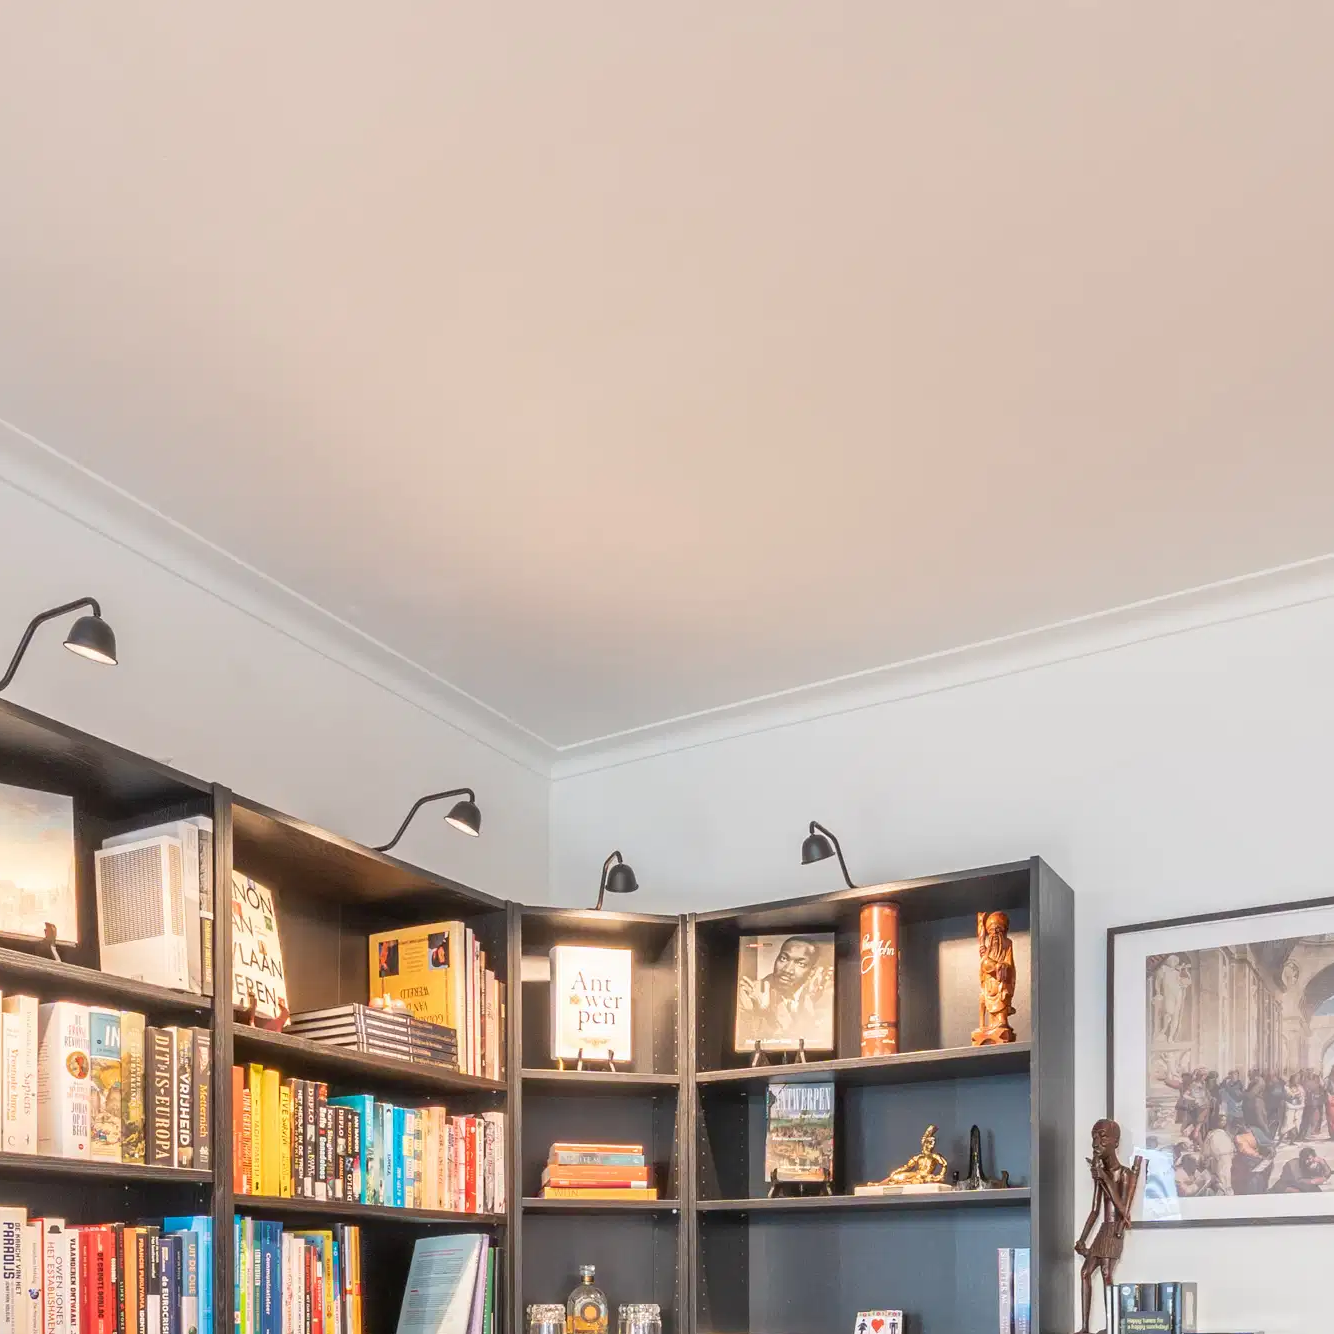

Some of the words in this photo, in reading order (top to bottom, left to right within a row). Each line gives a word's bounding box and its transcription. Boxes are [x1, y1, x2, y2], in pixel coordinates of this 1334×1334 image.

[232, 879, 273, 916] NON
[232, 914, 254, 937] AN
[571, 972, 612, 991] Ant
[585, 995, 622, 1009] wer
[578, 1010, 616, 1030] pen
[155, 1035, 170, 1065] DIT
[22, 1072, 35, 1115] Sapiens
[156, 1071, 170, 1088] IS
[179, 1072, 191, 1146] VRIJHEID
[199, 1084, 208, 1138] Metternich
[307, 1087, 315, 1123] DEFLO
[155, 1096, 171, 1160] EUROPA
[3, 1222, 15, 1279] PARADIJS
[47, 1242, 55, 1259] HET
[188, 1244, 196, 1258] UIT
[56, 1256, 64, 1289] OWEN
[188, 1260, 196, 1273] DE
[188, 1275, 196, 1295] OLIE
[56, 1292, 64, 1326] JONES
